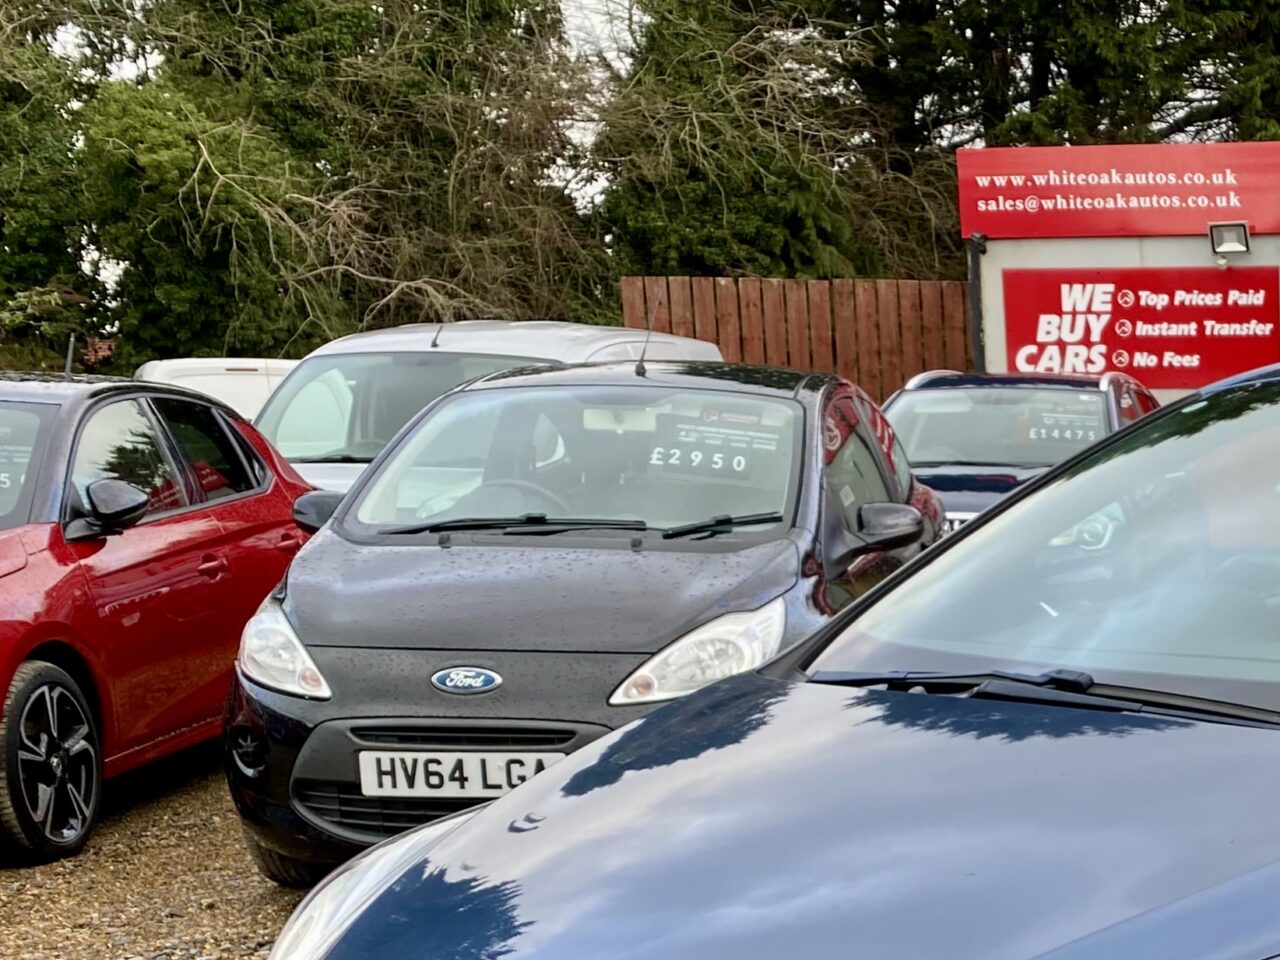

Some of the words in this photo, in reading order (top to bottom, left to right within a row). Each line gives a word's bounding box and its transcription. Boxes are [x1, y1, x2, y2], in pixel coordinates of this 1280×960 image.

[975, 168, 1238, 188] www.whiteoakautos.co.uk
[977, 191, 1242, 212] sales@whiteoakautos.co.uk
[1060, 283, 1115, 312] WE
[1138, 290, 1170, 311] Top
[1173, 289, 1223, 307] Prices
[1227, 289, 1266, 306] Paid
[1036, 314, 1112, 343] BUY
[1135, 320, 1198, 337] Instant
[1203, 319, 1274, 337] Transfer
[1015, 345, 1107, 373] CARS
[1132, 351, 1159, 368] No
[1162, 350, 1201, 368] Fees
[649, 447, 746, 472] £2950
[375, 757, 469, 790] HV64
